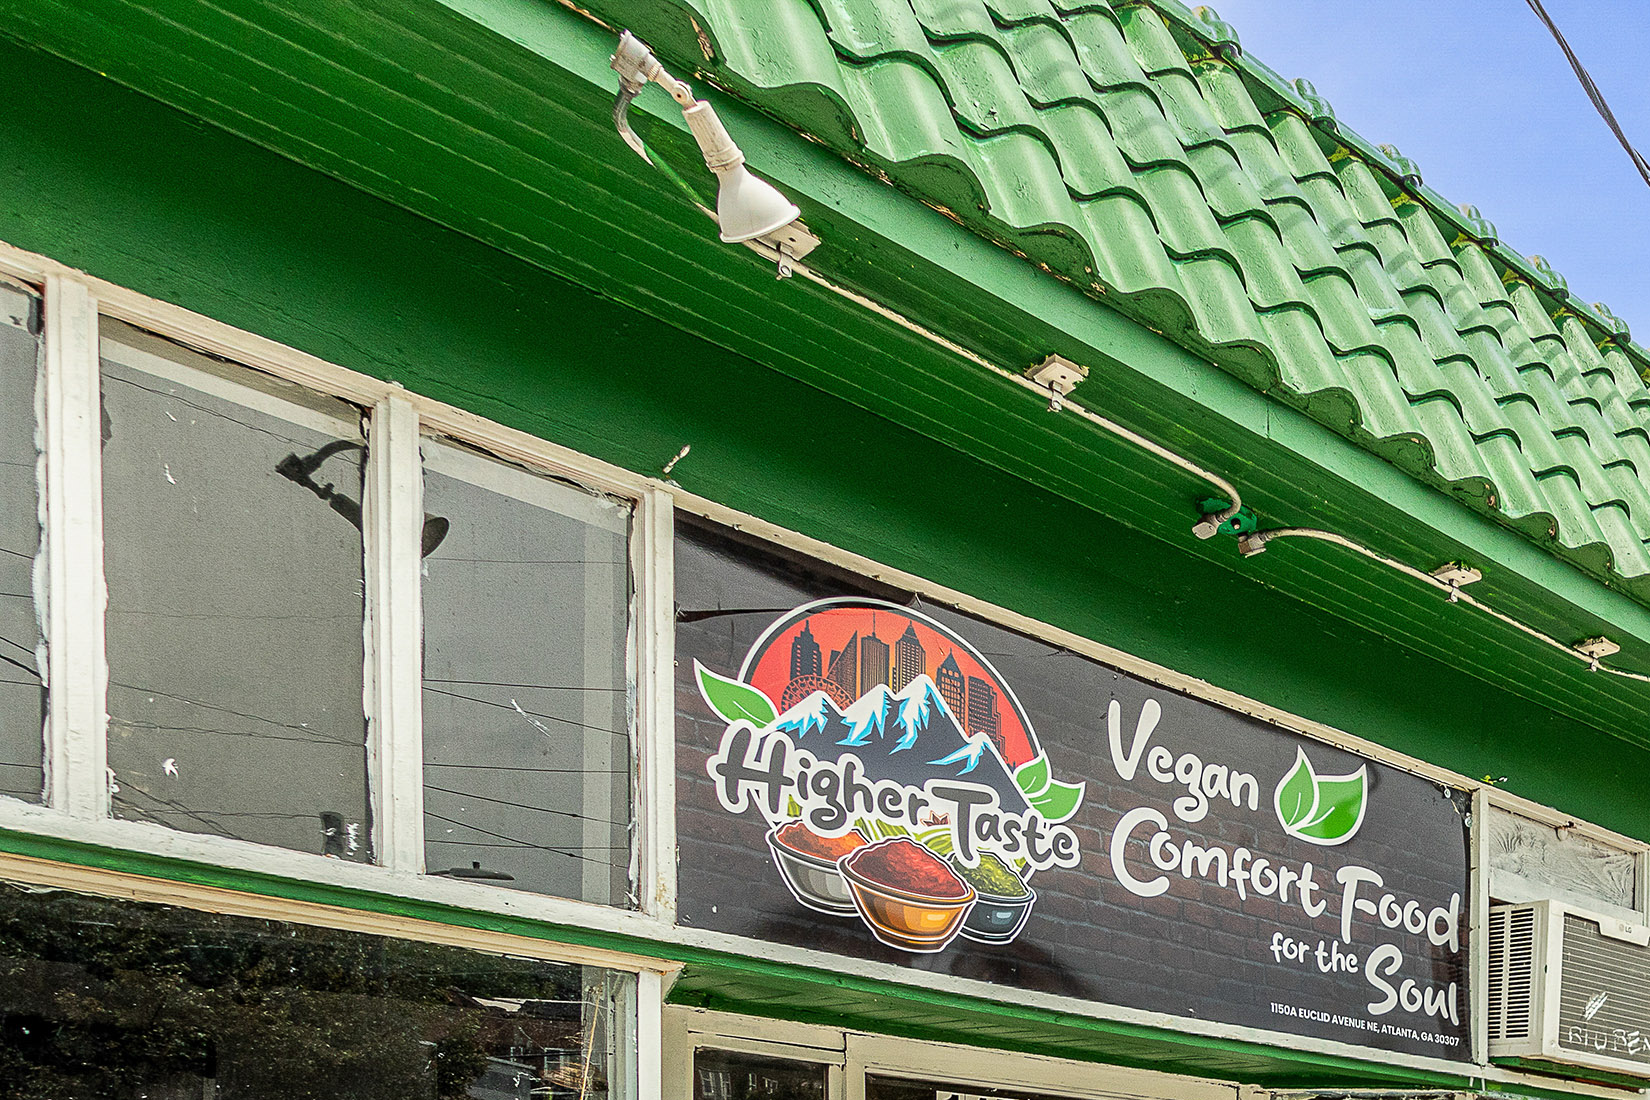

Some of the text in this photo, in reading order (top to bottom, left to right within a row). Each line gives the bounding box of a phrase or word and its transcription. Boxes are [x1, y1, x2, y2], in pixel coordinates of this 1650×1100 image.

[714, 725, 1076, 863] Higher Taste
[1107, 698, 1259, 823] Vegan
[1110, 807, 1460, 954] Comfort Food
[1269, 931, 1460, 1027] for the Soul
[1270, 1002, 1460, 1047] 1150A EUCLID AVENUE NE, ATLANTA, GA 30307
